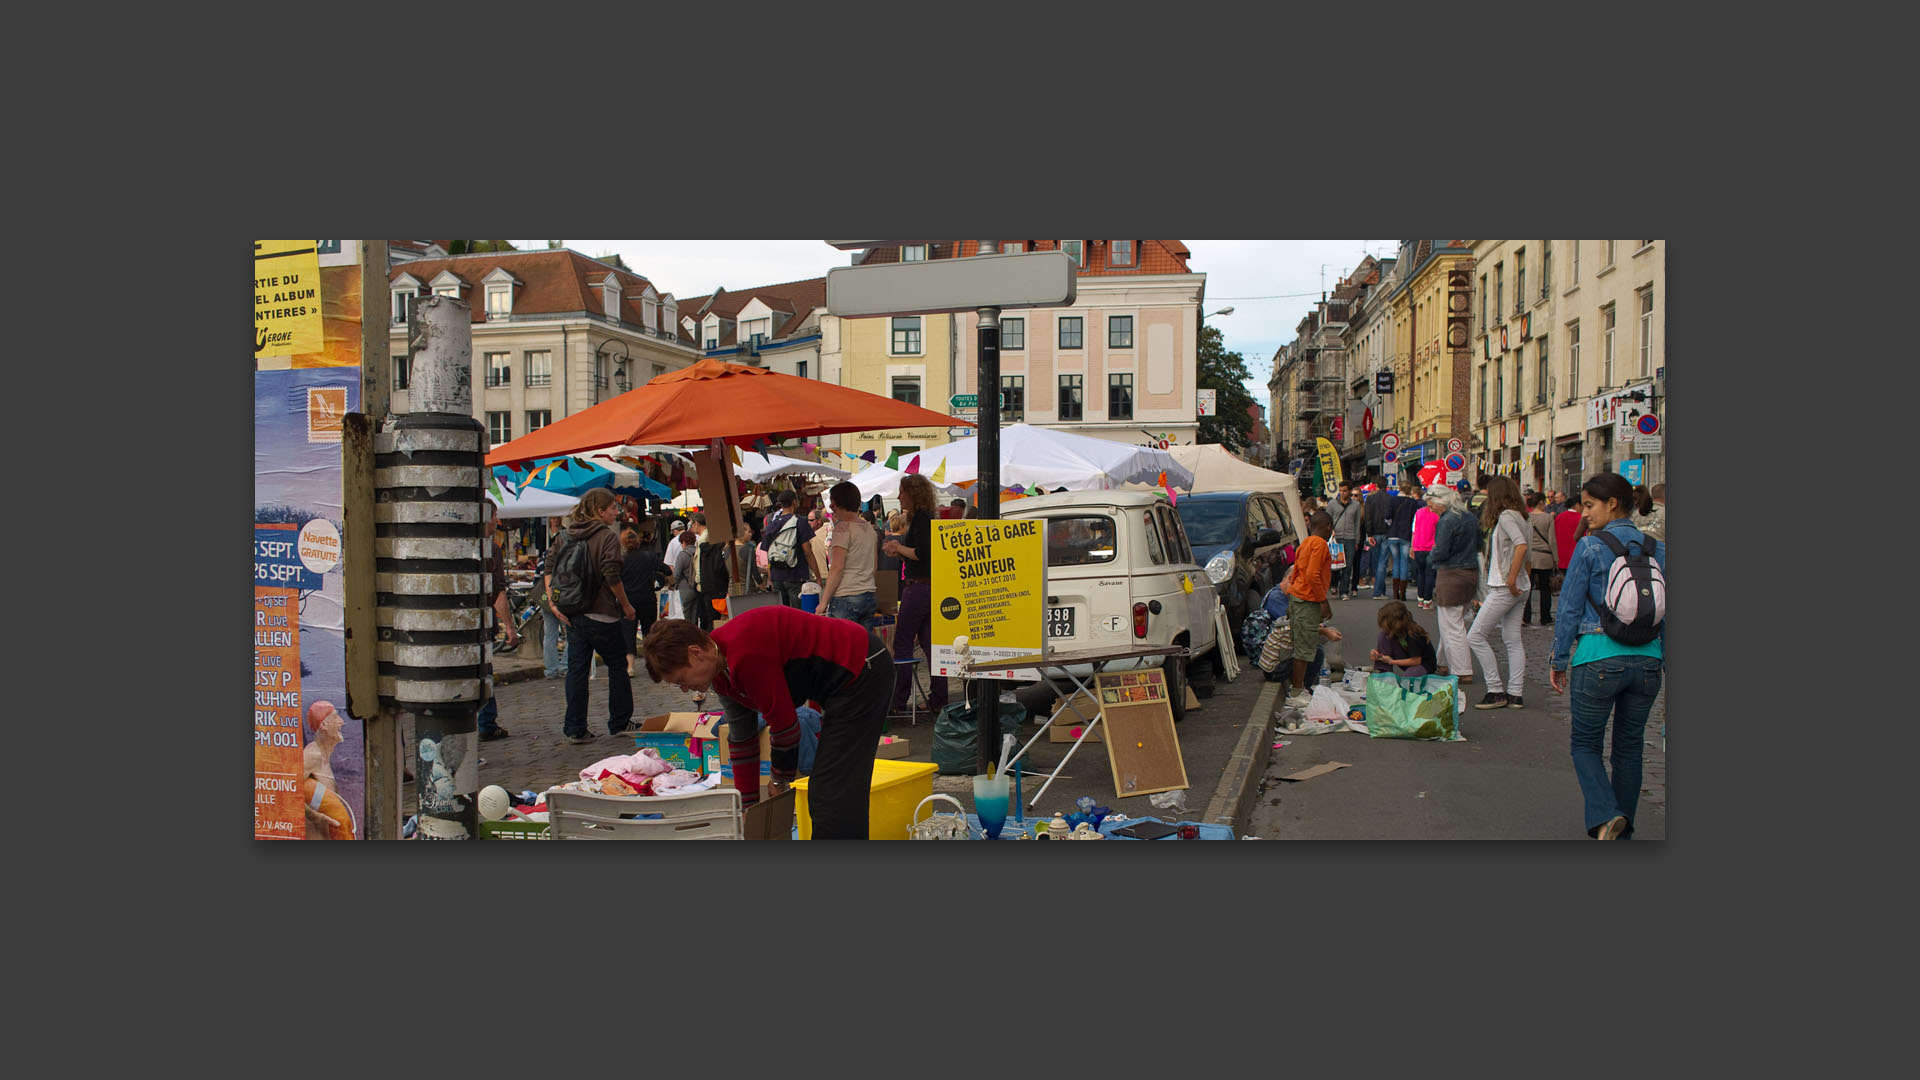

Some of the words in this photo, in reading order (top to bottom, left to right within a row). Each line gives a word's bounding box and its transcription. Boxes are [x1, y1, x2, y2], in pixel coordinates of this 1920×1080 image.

[283, 274, 298, 285] DU
[256, 295, 269, 304] EL
[274, 289, 315, 302] ALBUM
[256, 306, 306, 320] NTIERES
[303, 531, 337, 547] Navette
[940, 529, 972, 551] l'été
[975, 527, 983, 544] à
[986, 525, 1000, 542] la
[1003, 521, 1036, 539] GARE
[260, 541, 295, 559] SEPT.
[301, 547, 337, 562] GRATUITE
[957, 544, 992, 563] SAINT
[270, 564, 305, 582] SEPT.
[959, 557, 1016, 579] SAUVEUR
[991, 576, 1001, 584] OCT
[1002, 574, 1016, 582] 2010
[273, 596, 289, 606] SET
[256, 611, 266, 626] R
[1112, 617, 1119, 630] F
[262, 656, 282, 667] LIVE
[282, 671, 291, 687] P
[280, 717, 298, 727] LIVE
[273, 732, 298, 747] 001
